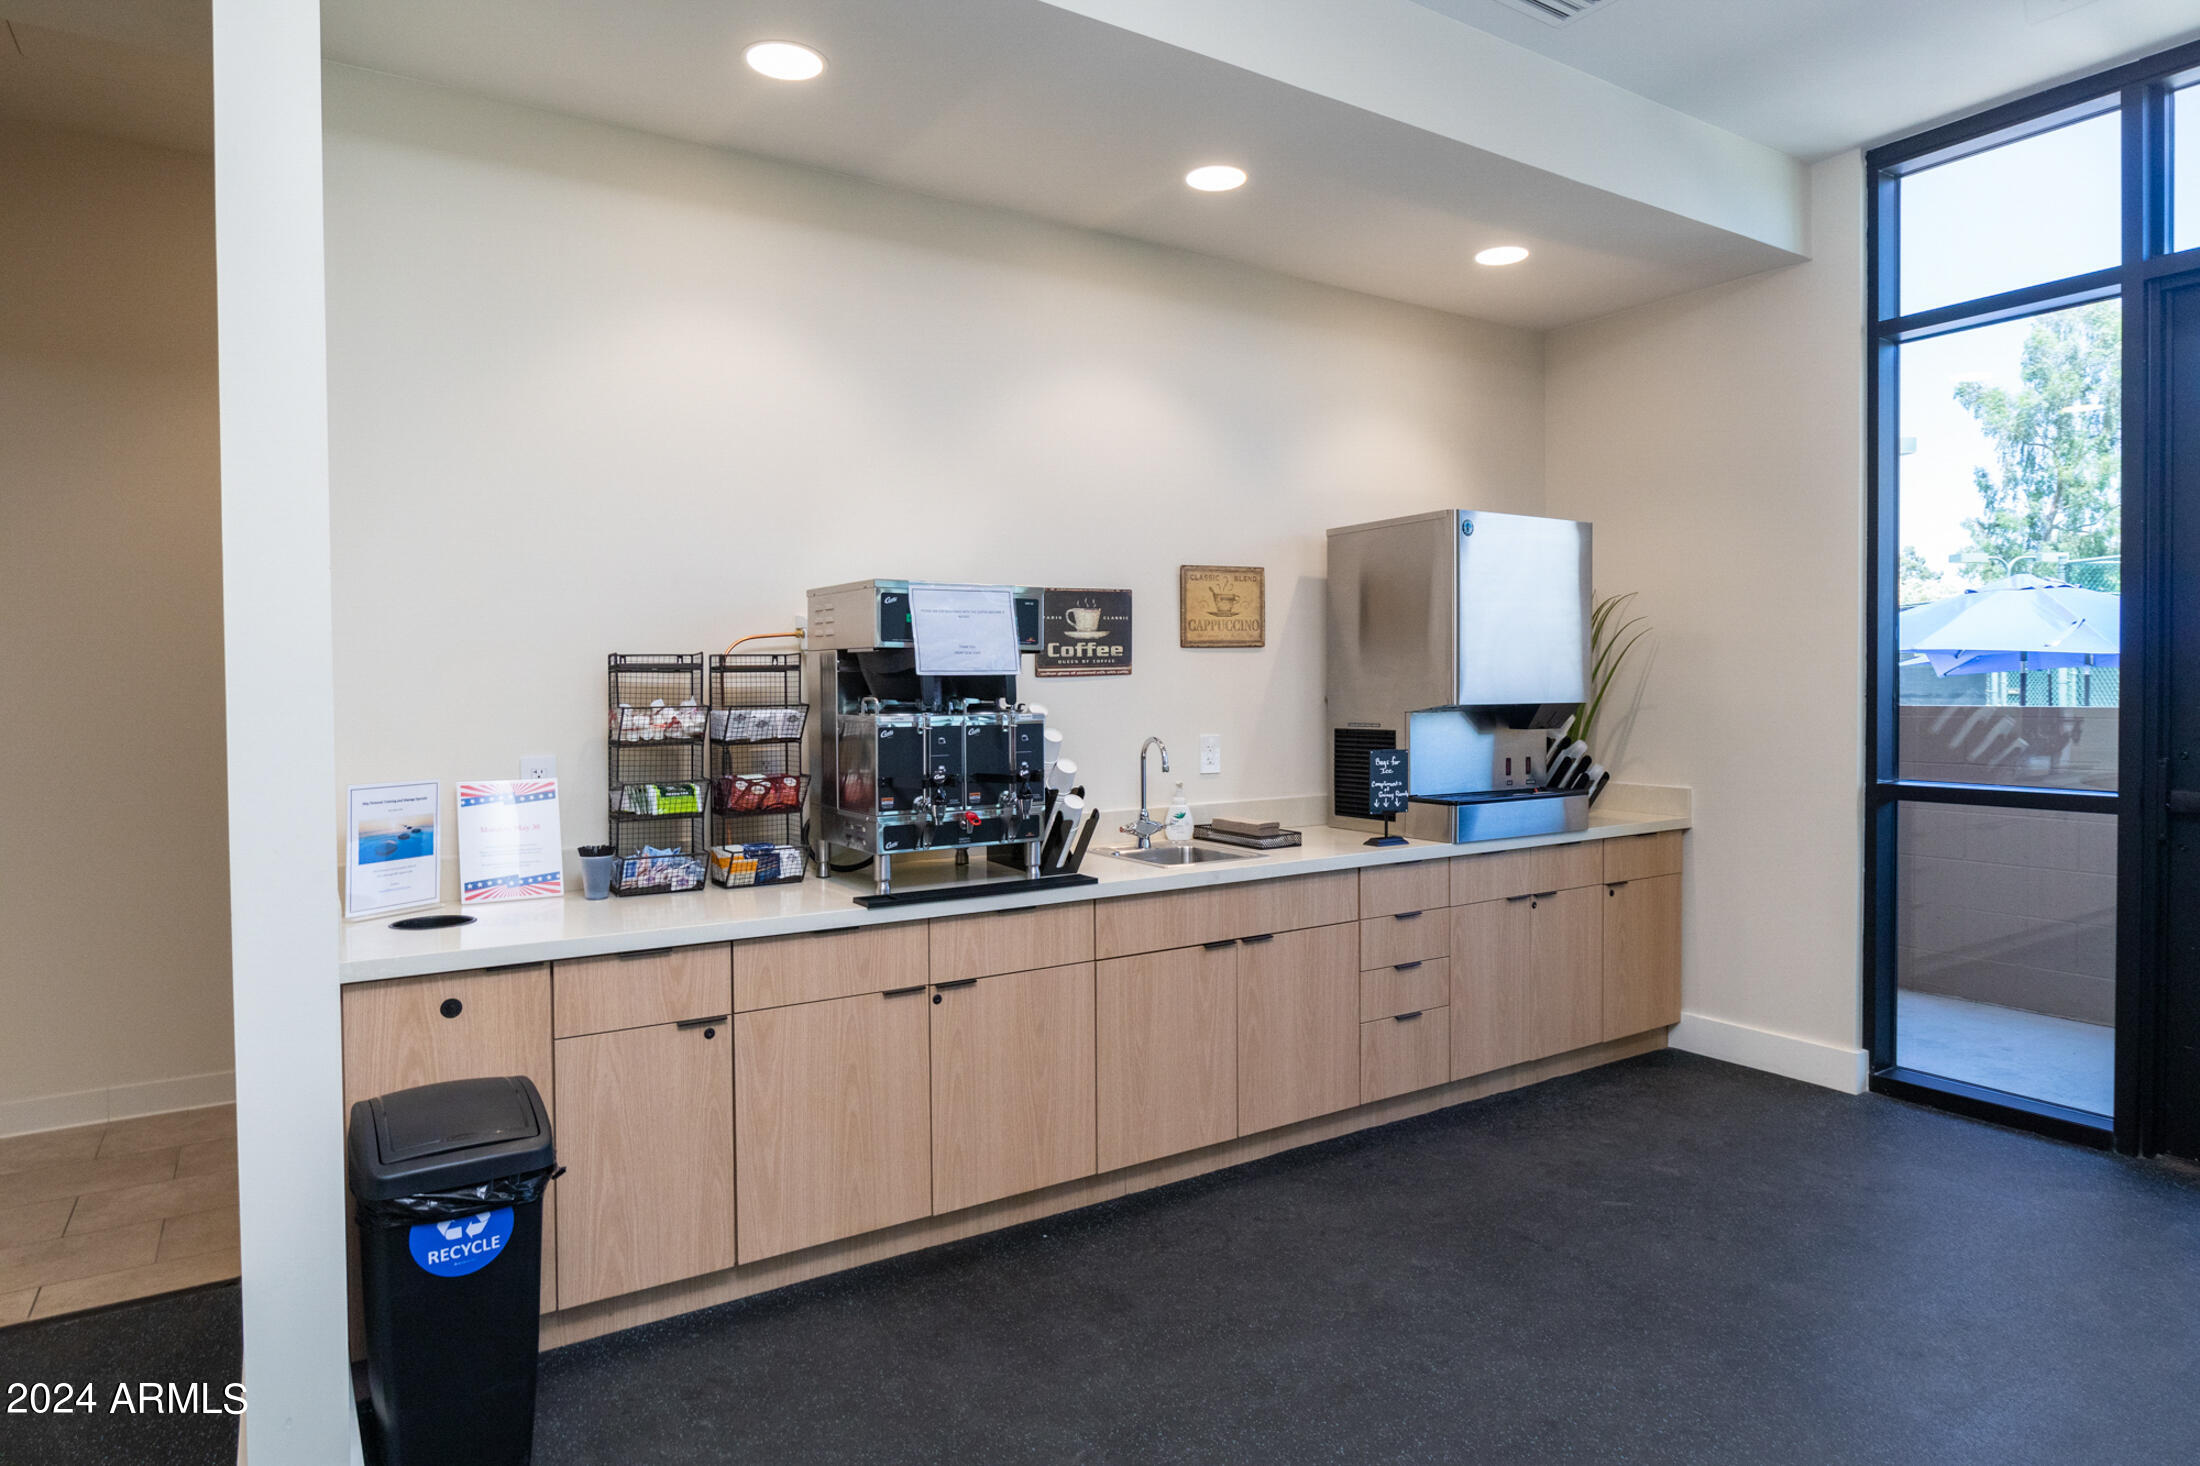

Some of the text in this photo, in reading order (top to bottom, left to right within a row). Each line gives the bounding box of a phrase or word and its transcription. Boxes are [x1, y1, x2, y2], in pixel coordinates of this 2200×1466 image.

[1190, 574, 1220, 582] CLASSIC
[1188, 619, 1260, 632] CAPPUCCINO
[1047, 641, 1124, 657] Coffee
[1390, 755, 1400, 766] for
[428, 1235, 501, 1265] RECYCLE
